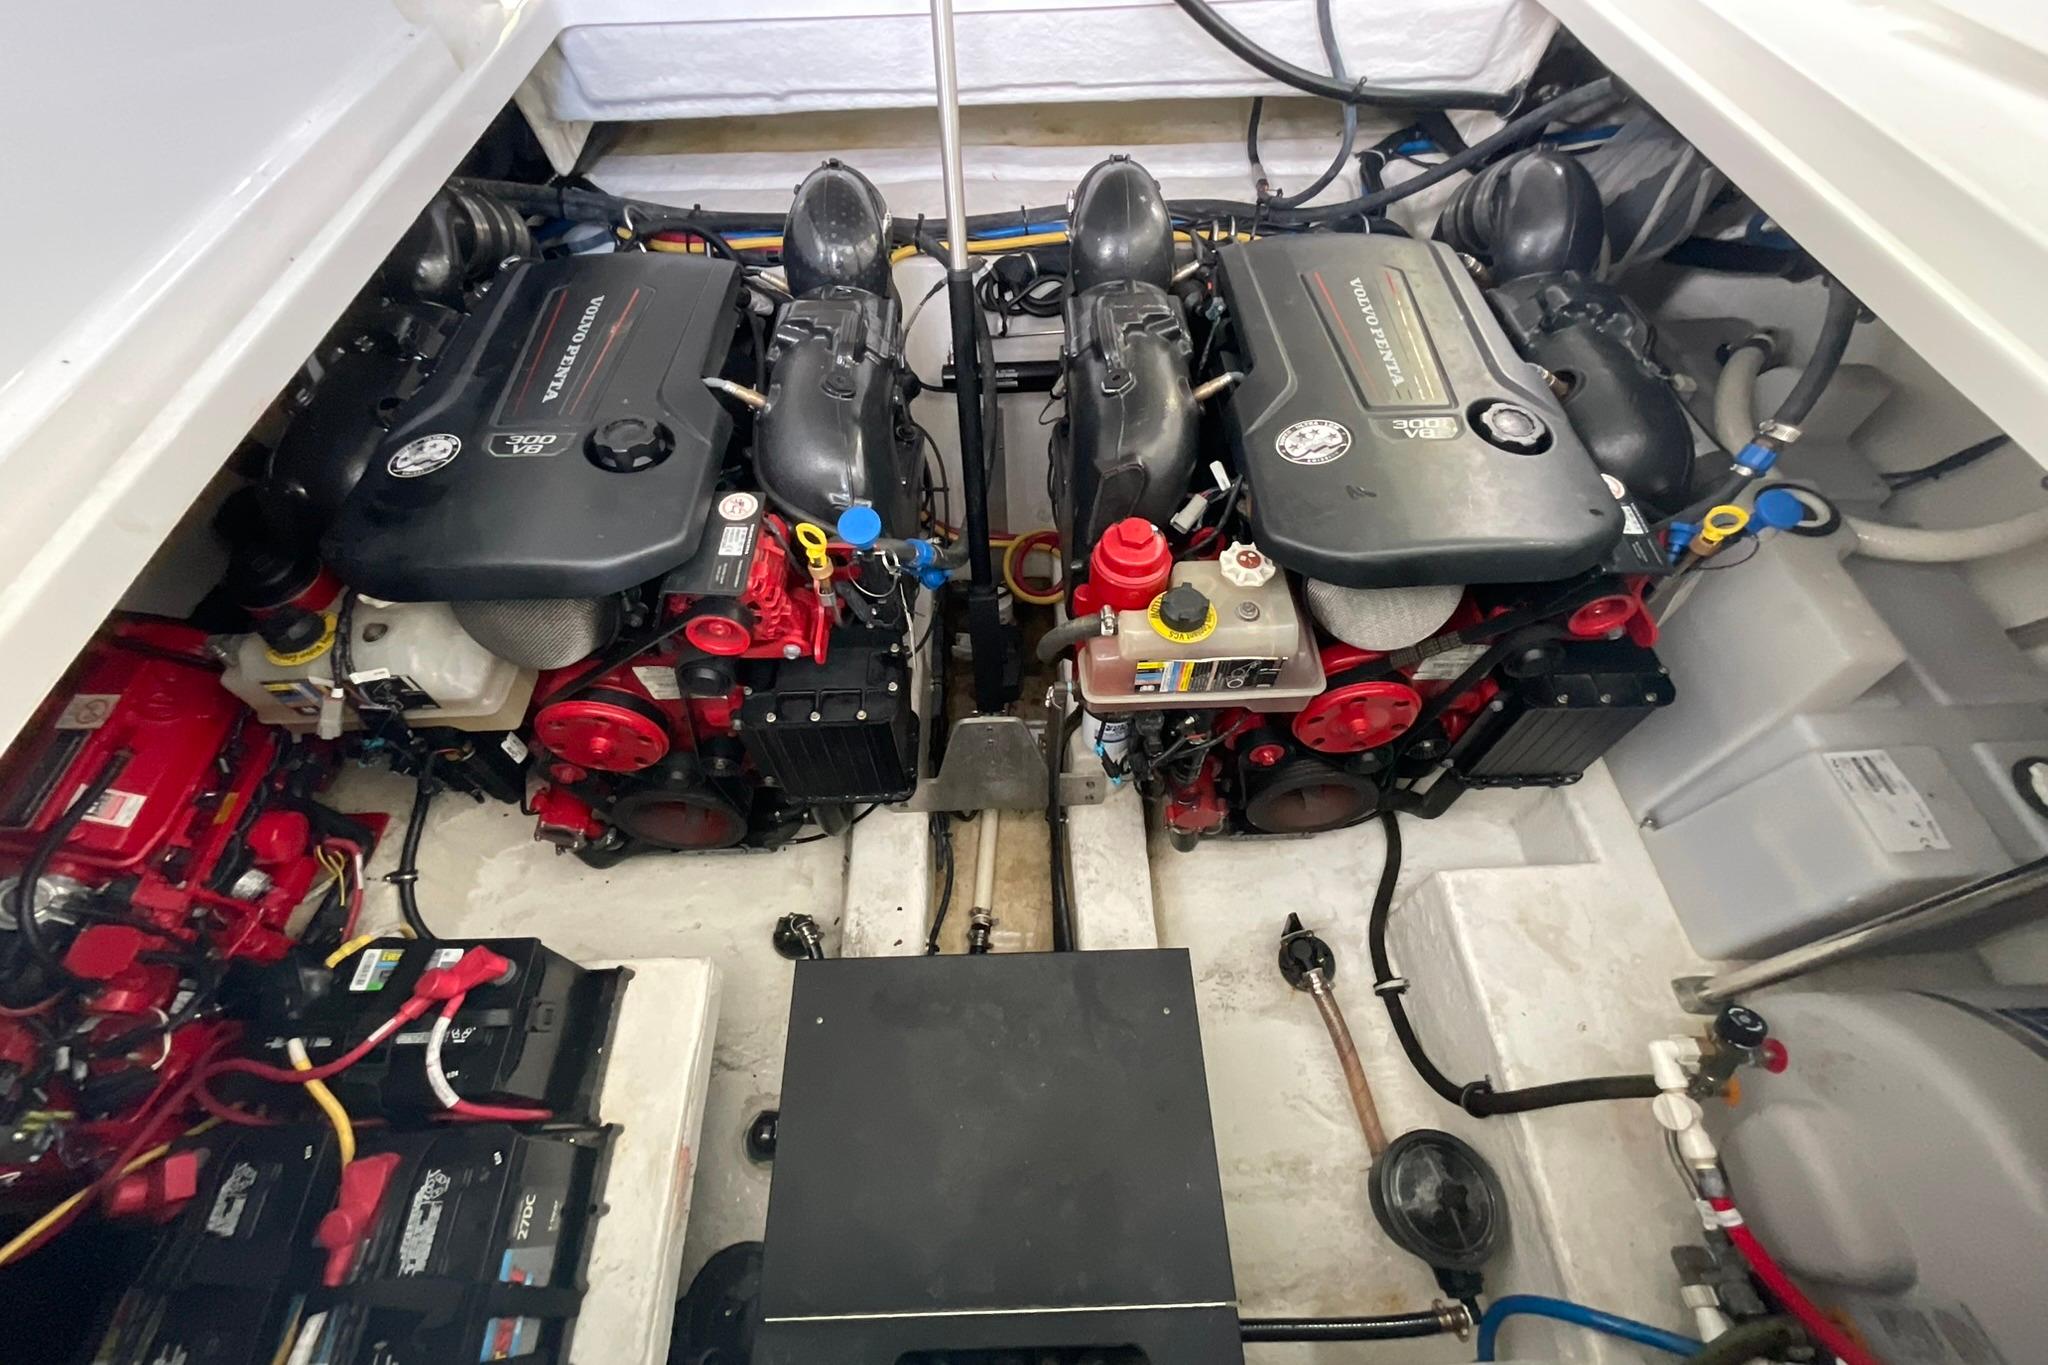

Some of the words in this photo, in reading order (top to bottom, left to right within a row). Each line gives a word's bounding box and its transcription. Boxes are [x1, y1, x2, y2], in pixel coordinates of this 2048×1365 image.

[572, 294, 605, 343] VOLVO
[1350, 277, 1379, 326] VOLVO
[1370, 328, 1405, 387] PENTA
[542, 344, 582, 403] PENTA
[1392, 419, 1440, 430] 300
[1404, 428, 1436, 439] V8
[505, 434, 557, 445] 300
[512, 444, 544, 454] V8
[517, 1194, 536, 1240] 27DC
